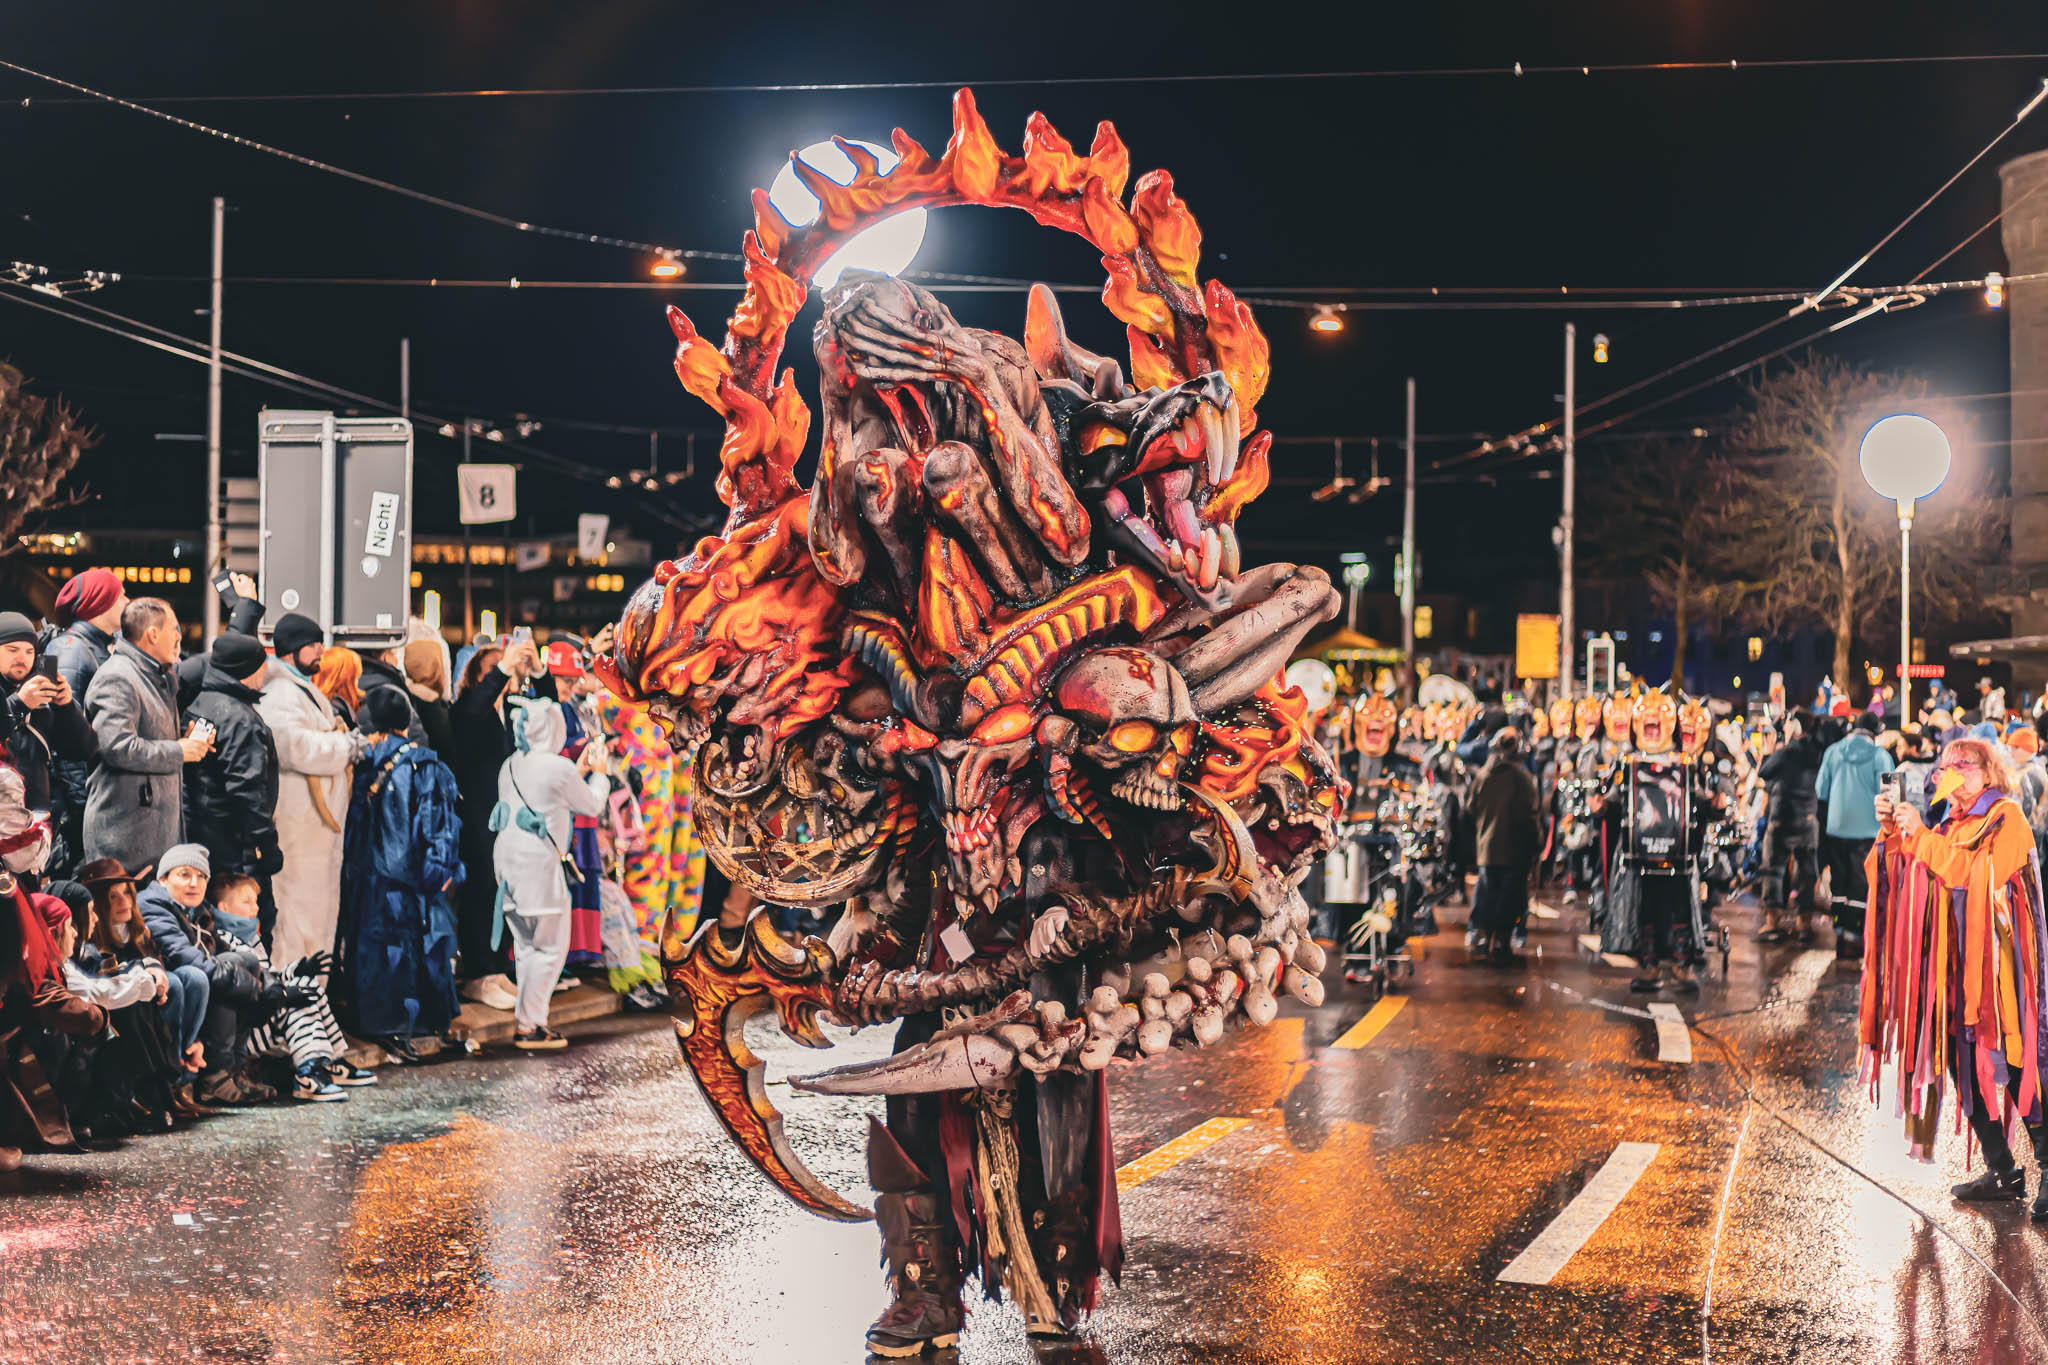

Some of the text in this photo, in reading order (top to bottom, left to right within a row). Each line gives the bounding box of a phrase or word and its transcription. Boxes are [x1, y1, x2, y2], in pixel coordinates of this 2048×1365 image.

[480, 485, 495, 509] 8
[372, 499, 392, 549] Nicht.
[587, 528, 598, 546] 7
